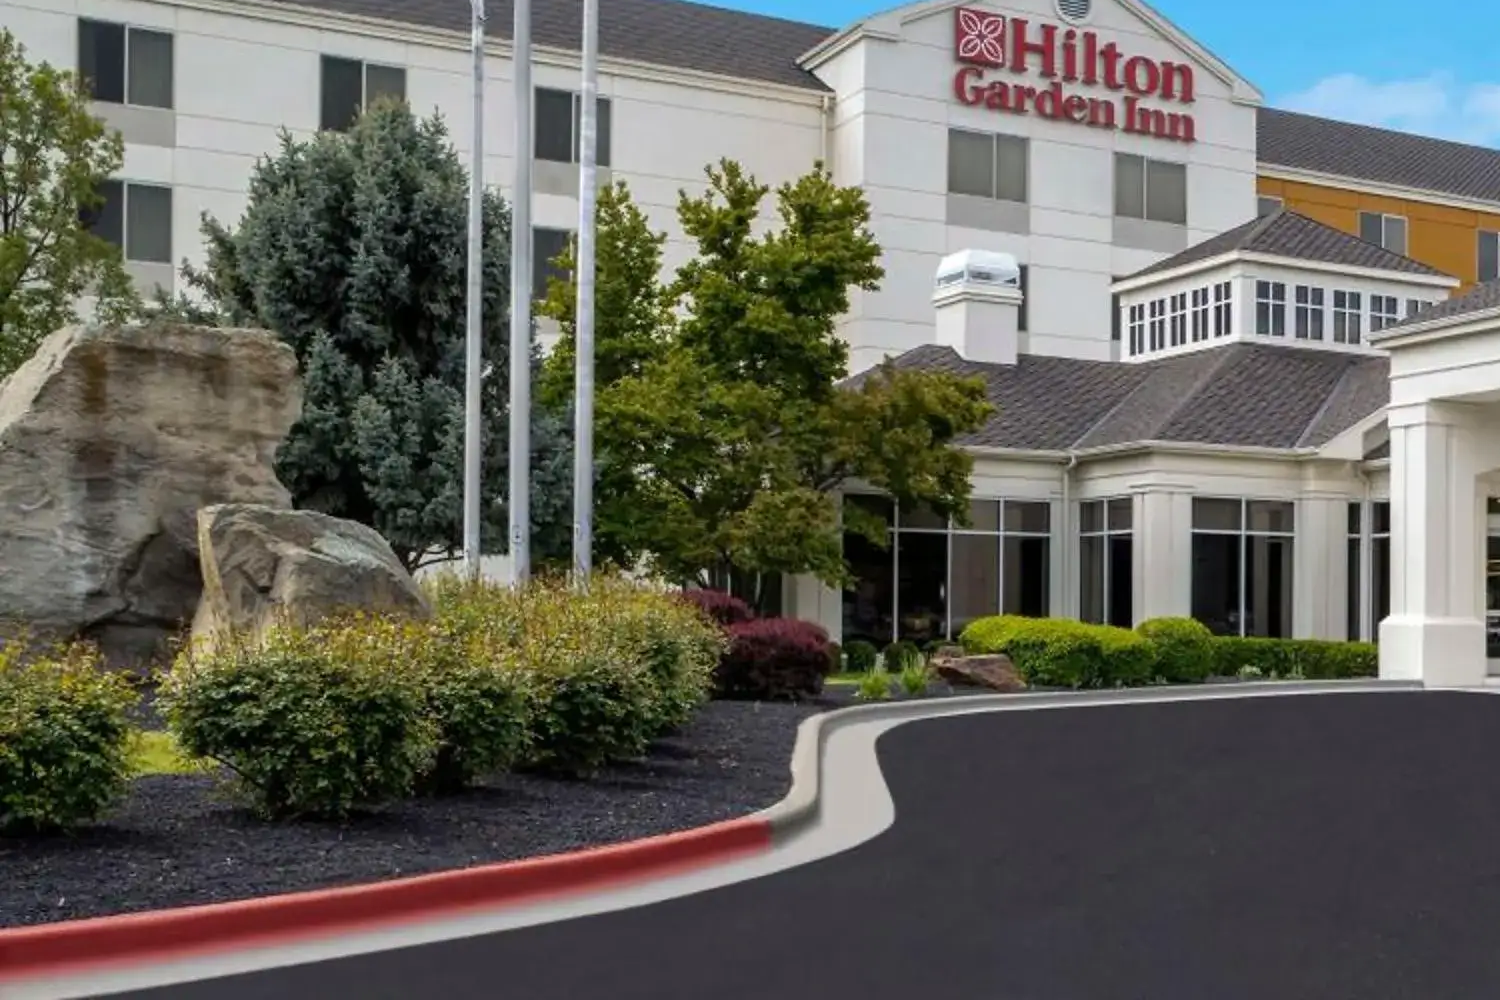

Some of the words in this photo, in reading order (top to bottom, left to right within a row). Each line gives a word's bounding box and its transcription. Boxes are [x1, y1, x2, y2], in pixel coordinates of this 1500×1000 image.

[1009, 17, 1196, 103] Hilton
[954, 67, 1119, 130] Garden
[1122, 95, 1197, 142] Inn
